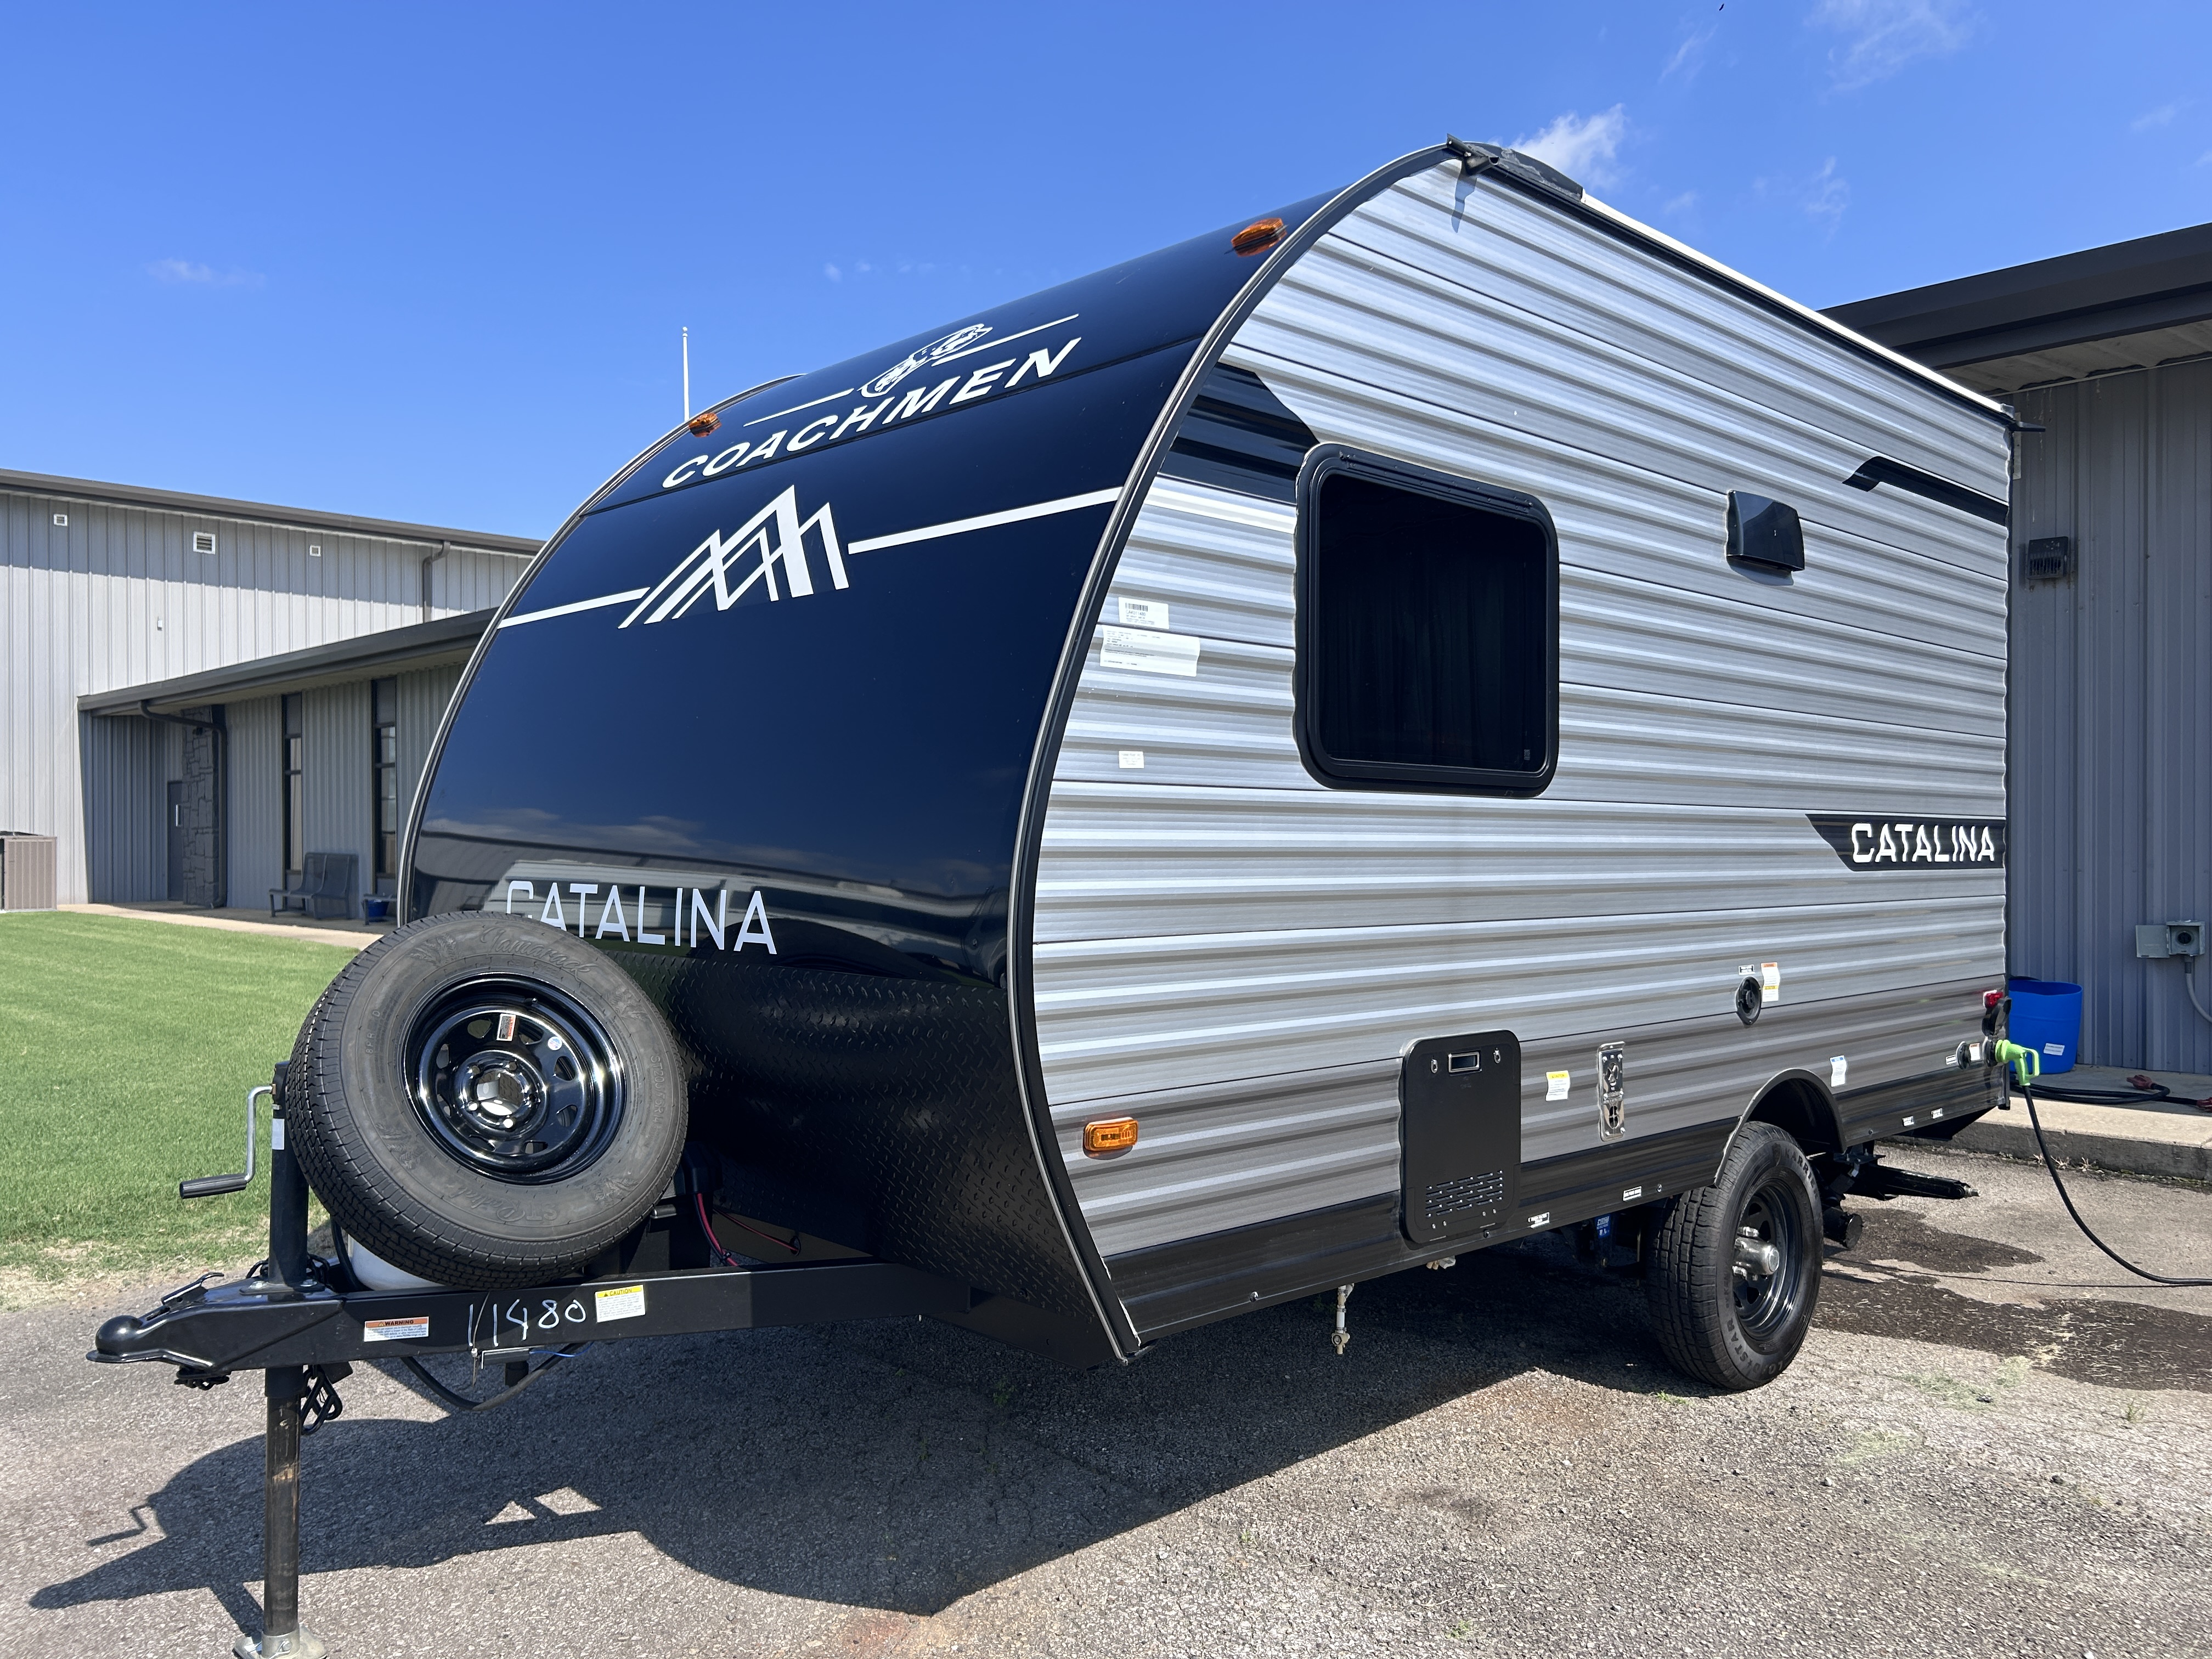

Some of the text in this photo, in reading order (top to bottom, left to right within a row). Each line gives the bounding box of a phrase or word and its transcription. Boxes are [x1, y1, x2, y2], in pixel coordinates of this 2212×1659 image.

[662, 337, 1082, 488] COACHMEN
[1851, 822, 1995, 864] CATALINA
[506, 880, 777, 955] CATALINA
[480, 924, 599, 983] Tamarack
[610, 1288, 632, 1296] CAUTION
[467, 1299, 586, 1347] 11480
